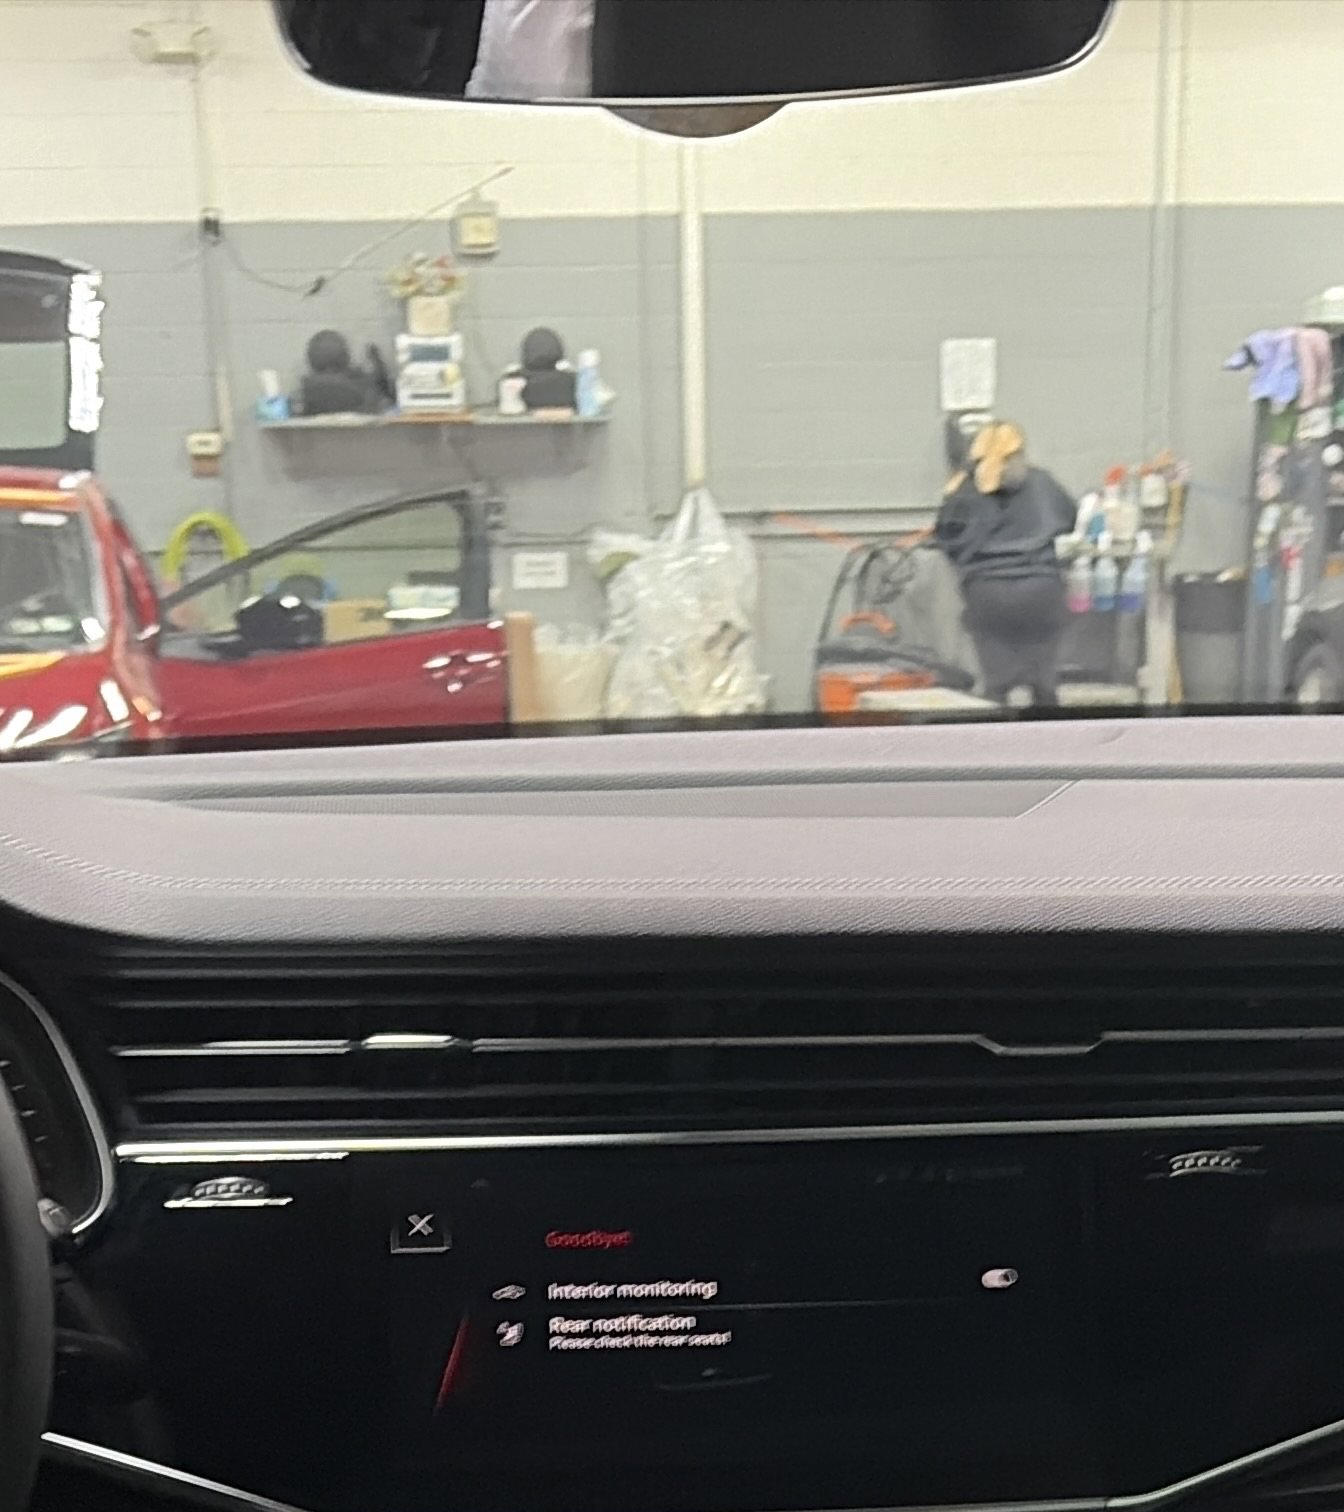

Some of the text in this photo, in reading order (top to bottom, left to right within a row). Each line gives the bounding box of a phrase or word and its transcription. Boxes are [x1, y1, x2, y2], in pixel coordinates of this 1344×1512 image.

[548, 1278, 718, 1300] Interior monitoring
[549, 1313, 696, 1334] Rear notification
[549, 1335, 594, 1350] Please
[594, 1334, 632, 1348] check
[633, 1333, 657, 1347] the
[658, 1334, 688, 1347] rear
